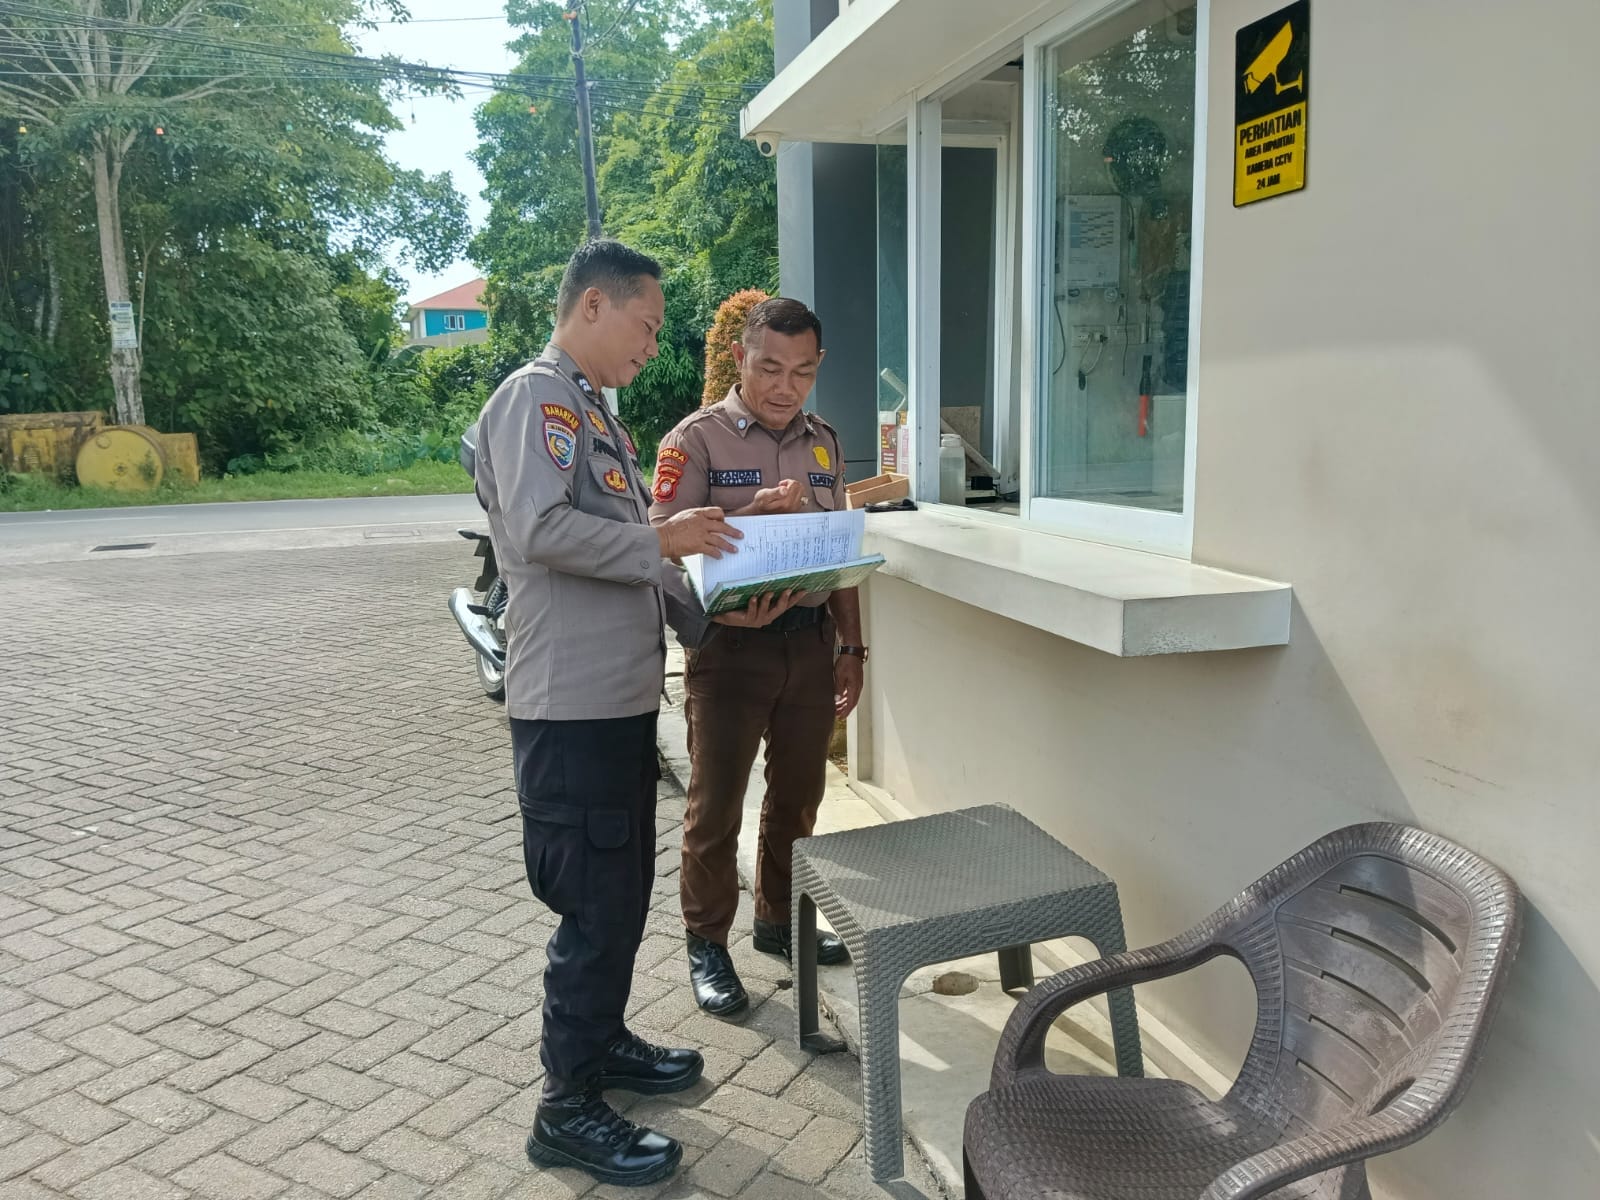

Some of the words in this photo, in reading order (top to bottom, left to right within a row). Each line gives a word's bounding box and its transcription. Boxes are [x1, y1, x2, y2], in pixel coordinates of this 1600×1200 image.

[1240, 108, 1302, 146] PERHATIAN
[1245, 144, 1262, 159] AREA
[1246, 158, 1274, 176] KAMERA
[1275, 152, 1293, 167] CCTV
[1256, 178, 1266, 190] 24
[660, 448, 686, 462] POLDA
